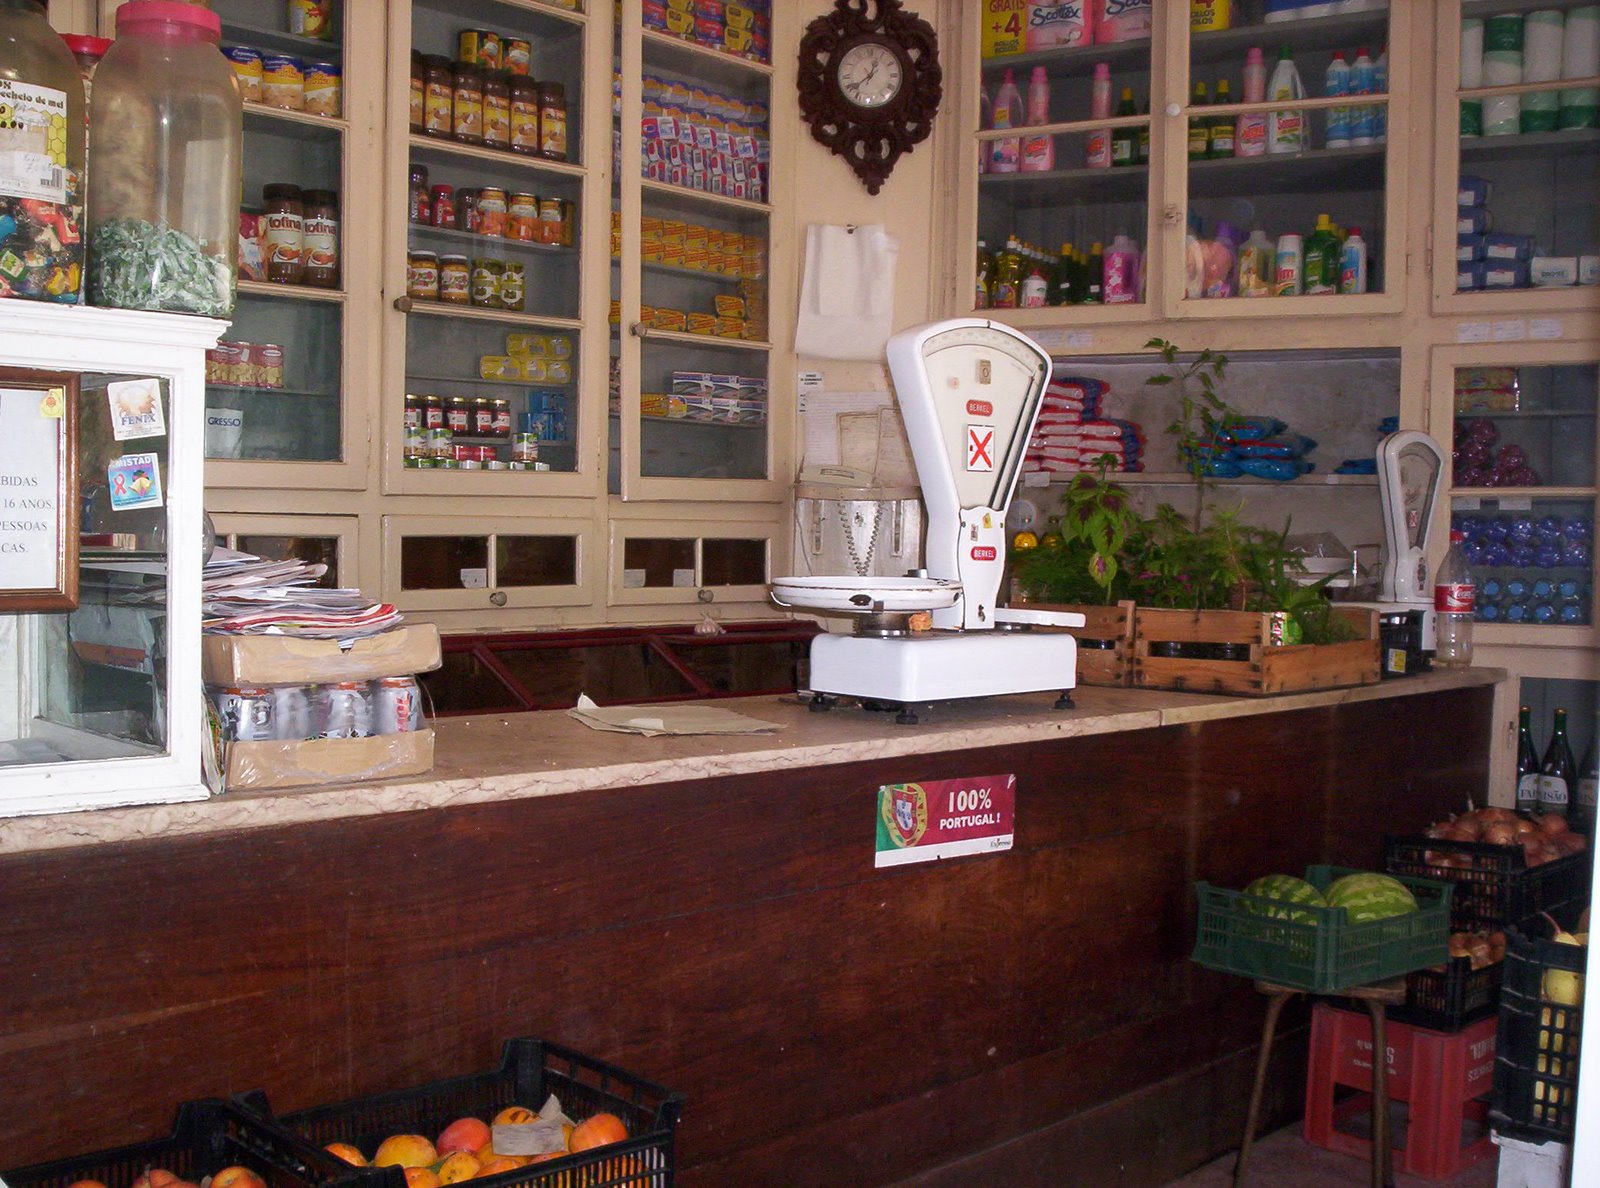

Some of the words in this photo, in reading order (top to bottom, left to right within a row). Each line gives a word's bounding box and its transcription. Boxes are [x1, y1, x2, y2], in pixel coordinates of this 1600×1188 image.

[1030, 5, 1081, 26] Scottex
[0, 90, 32, 102] echeio
[35, 96, 46, 105] de
[269, 216, 301, 230] tofina
[121, 414, 156, 426] FENIX
[0, 476, 38, 487] BIDAS
[4, 499, 15, 508] 16
[0, 543, 28, 553] CAS.
[974, 549, 994, 558] BERKEL
[948, 787, 992, 813] 100%
